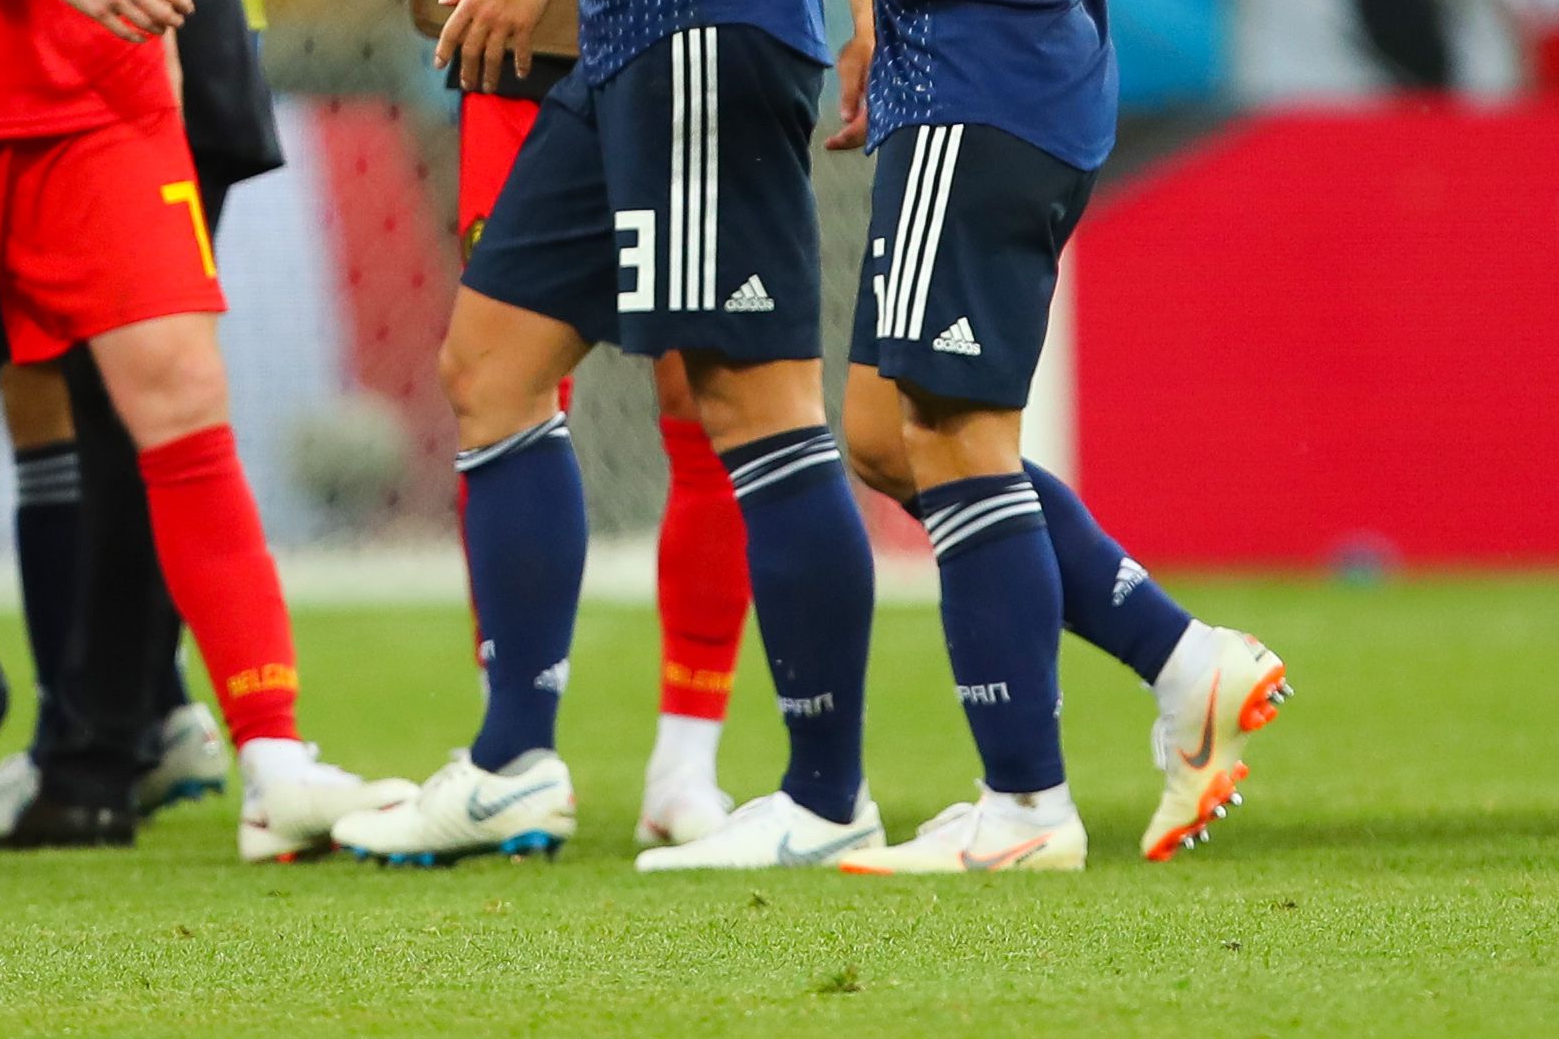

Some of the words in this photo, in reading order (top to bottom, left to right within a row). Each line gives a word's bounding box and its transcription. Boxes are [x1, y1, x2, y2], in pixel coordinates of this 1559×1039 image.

[160, 180, 218, 278] 7
[614, 209, 656, 312] 3
[932, 337, 982, 357] adidas
